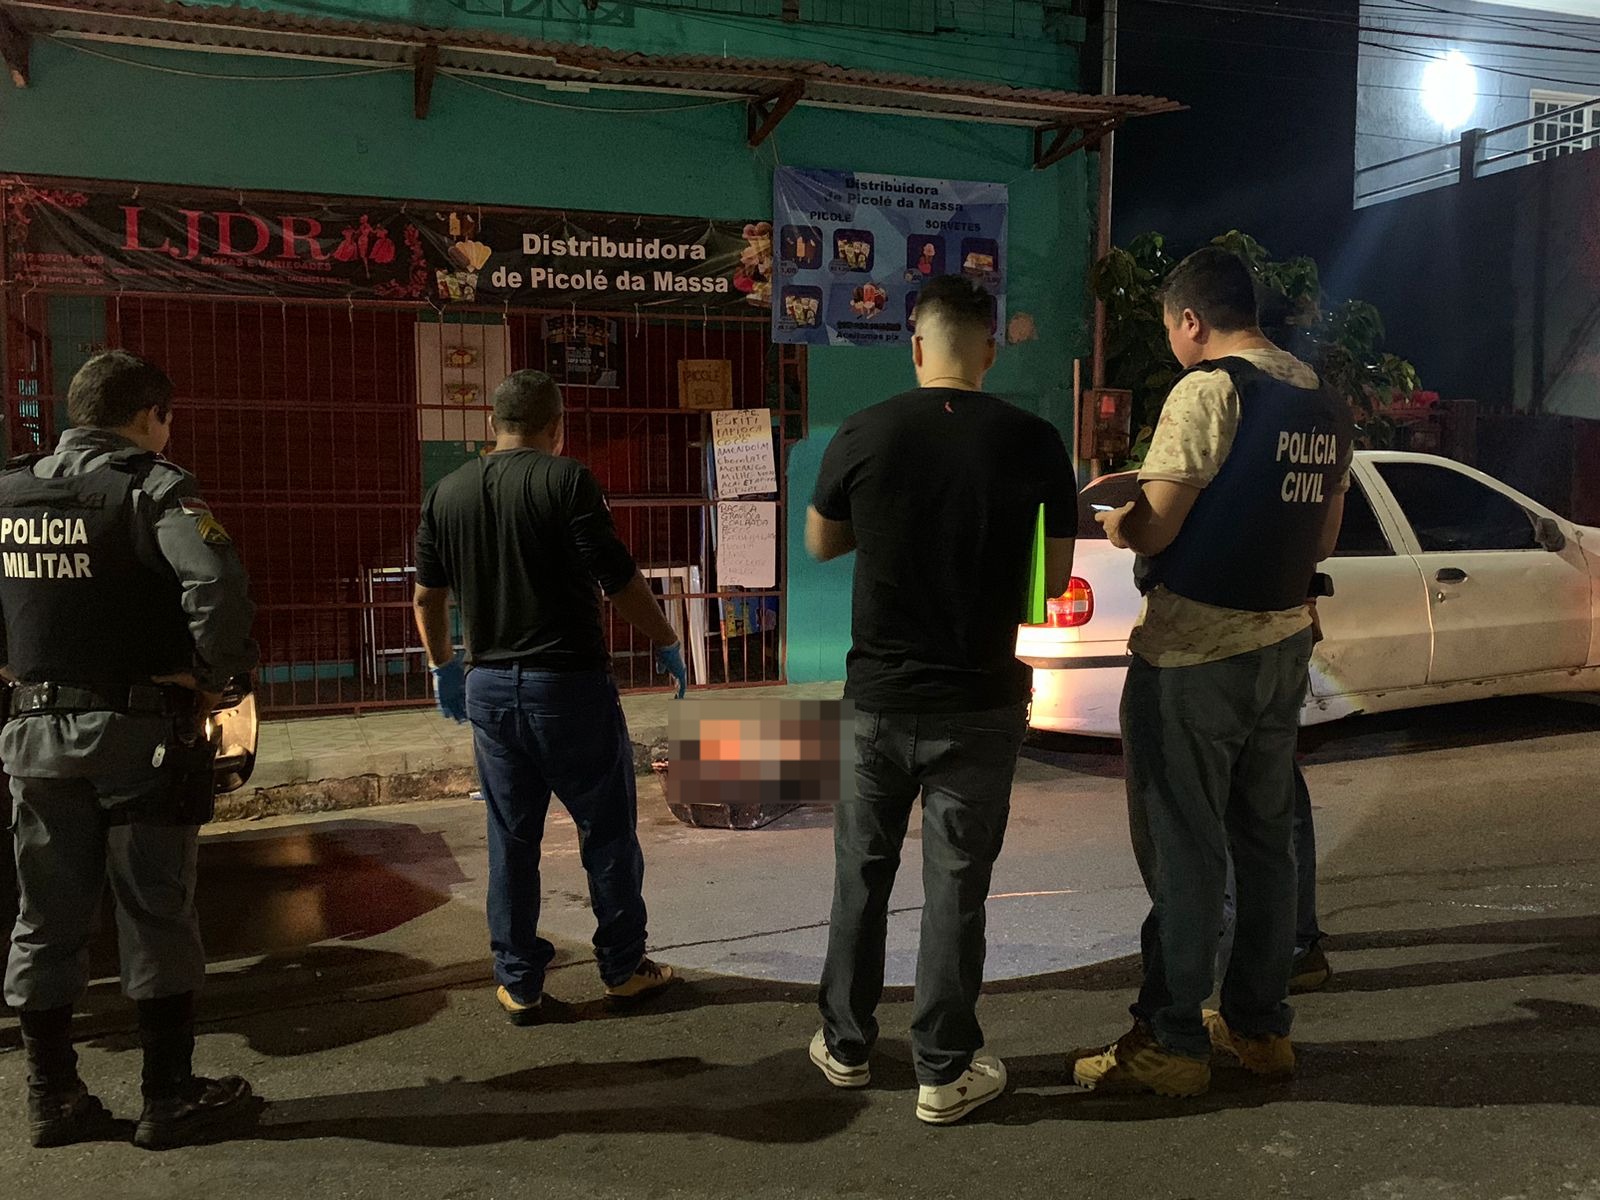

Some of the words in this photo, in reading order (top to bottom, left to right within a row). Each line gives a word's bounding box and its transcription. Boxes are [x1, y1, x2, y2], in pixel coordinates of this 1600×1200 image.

[845, 177, 939, 196] Distribuidora
[847, 191, 892, 207] Picolé
[897, 197, 914, 208] da
[919, 199, 964, 212] Massa
[119, 205, 333, 262] LJDR
[925, 219, 981, 232] SORVETES
[521, 233, 706, 261] Distribuidora
[200, 255, 245, 267] MODAS
[258, 258, 332, 272] VARIEDADES
[491, 266, 522, 289] de
[531, 267, 609, 291] Picolé
[615, 270, 646, 292] da
[653, 271, 729, 293] Massa
[1276, 425, 1337, 465] POLÍCIA
[1281, 471, 1324, 503] CIVIL
[0, 511, 88, 545] POLÍCIA
[2, 552, 95, 578] MILITAR
